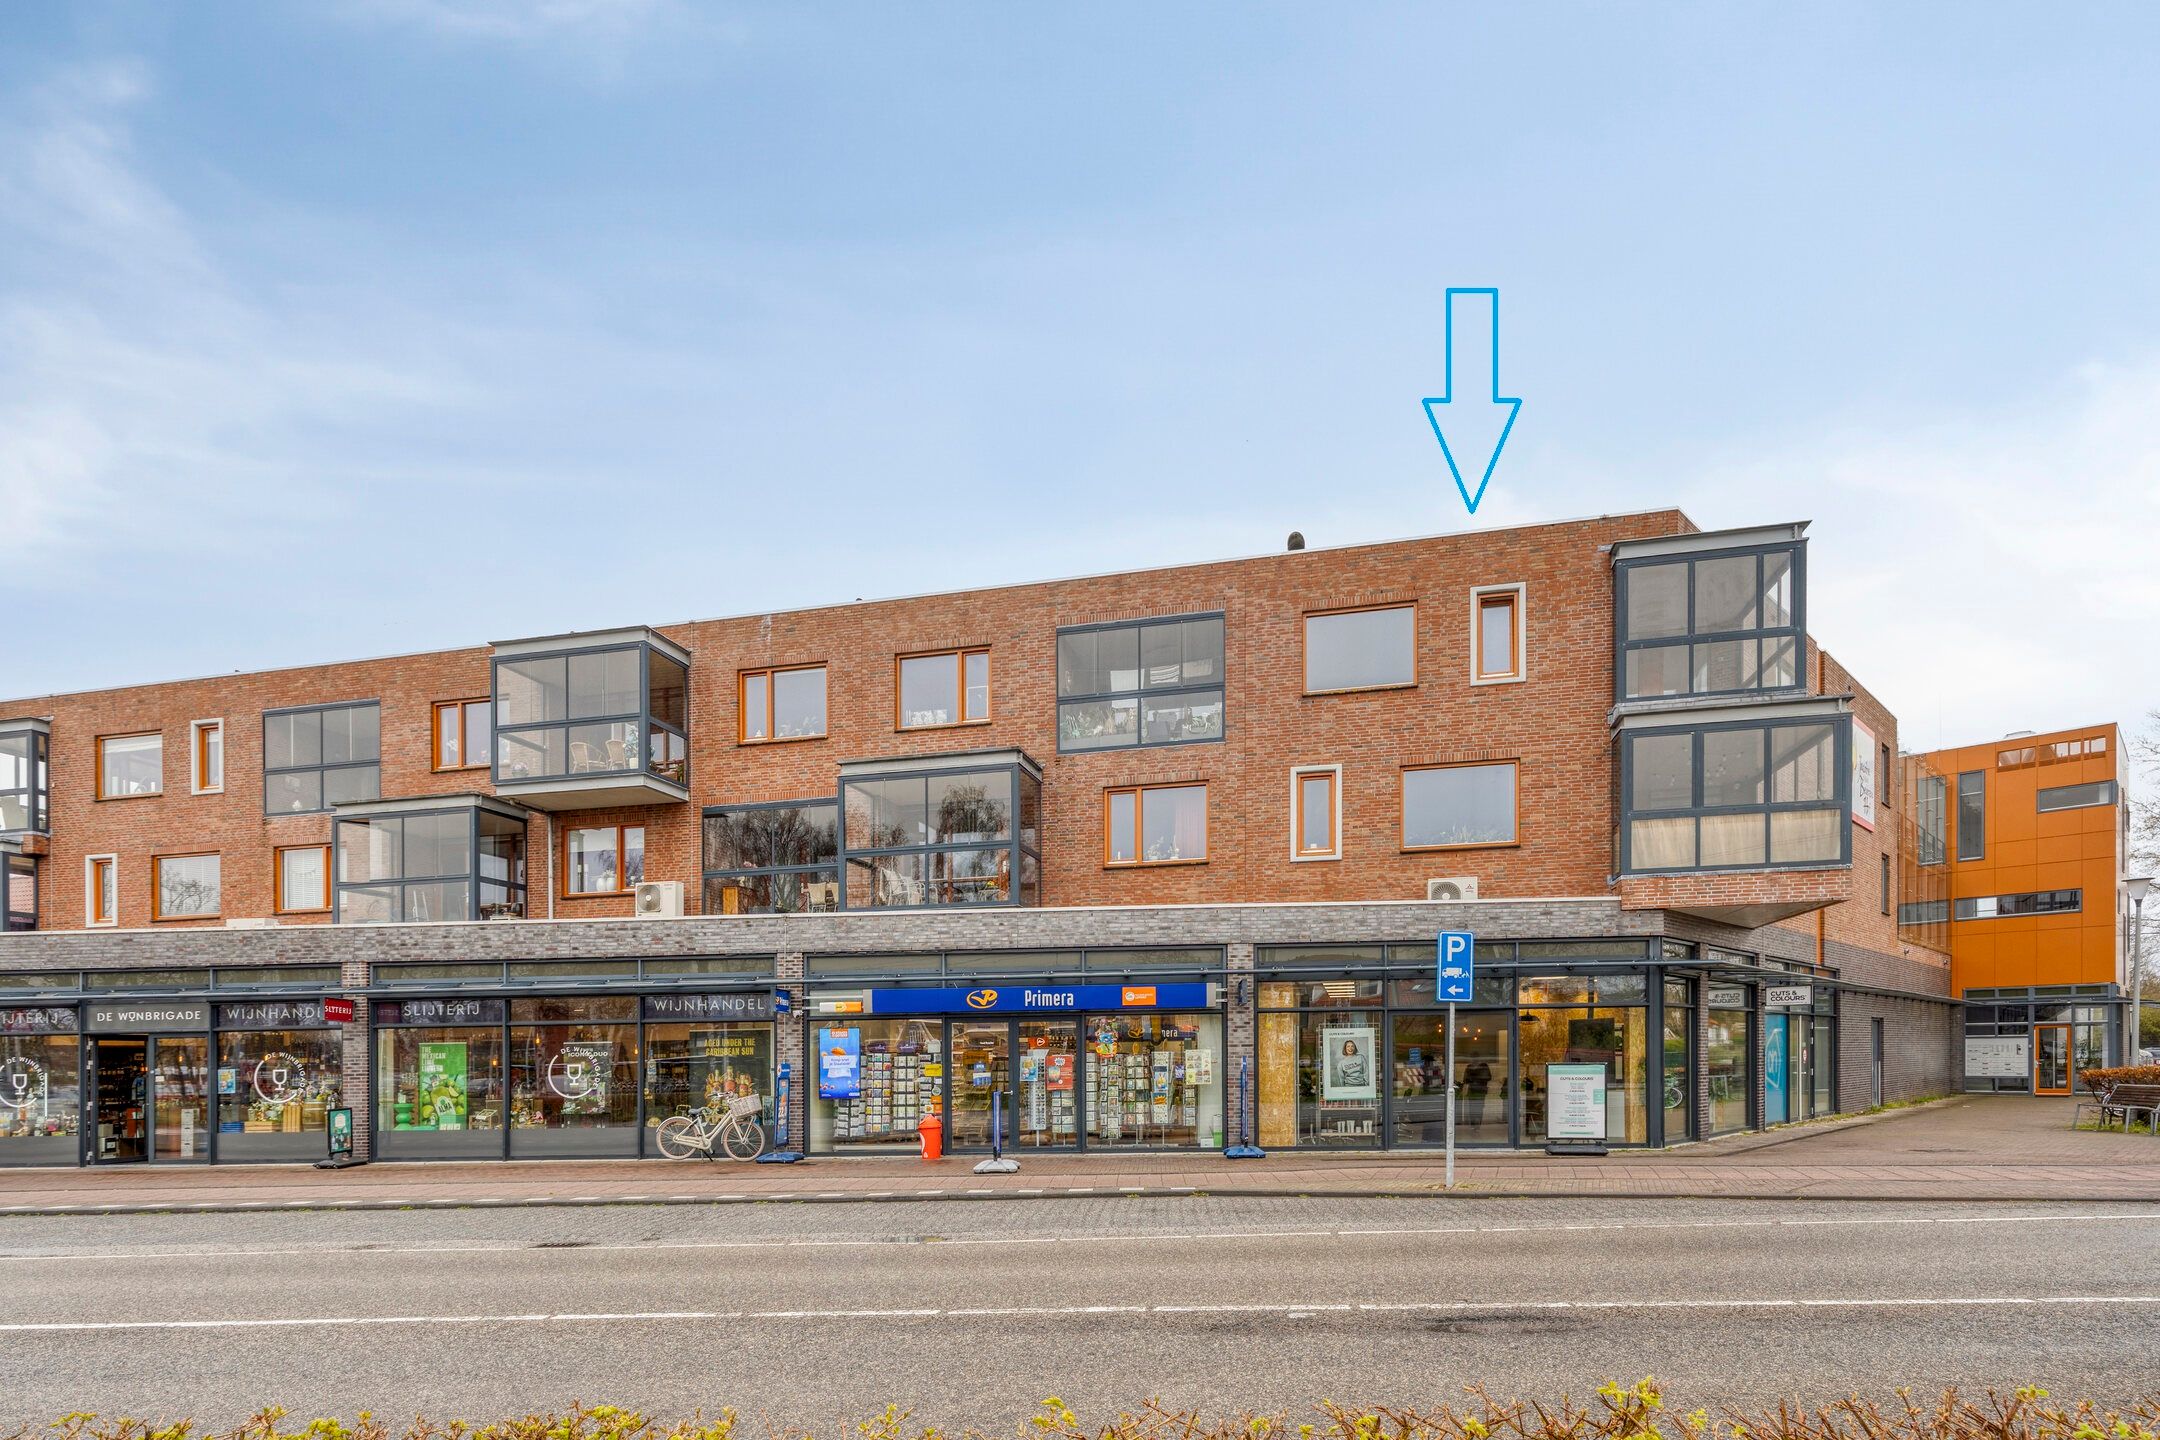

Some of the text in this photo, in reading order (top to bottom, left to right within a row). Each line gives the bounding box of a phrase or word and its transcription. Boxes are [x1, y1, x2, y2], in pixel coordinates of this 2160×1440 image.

[1447, 936, 1466, 961] P
[1025, 990, 1074, 1007] Primera
[404, 1004, 480, 1016] SLIJTERIJ
[654, 999, 765, 1011] WIJNHANDEL
[97, 1012, 113, 1022] DE
[227, 1007, 321, 1020] WIJNHAND
[744, 1038, 756, 1046] THE
[560, 1047, 571, 1055] DE
[741, 1047, 754, 1056] SUN
[6, 1056, 16, 1065] DE
